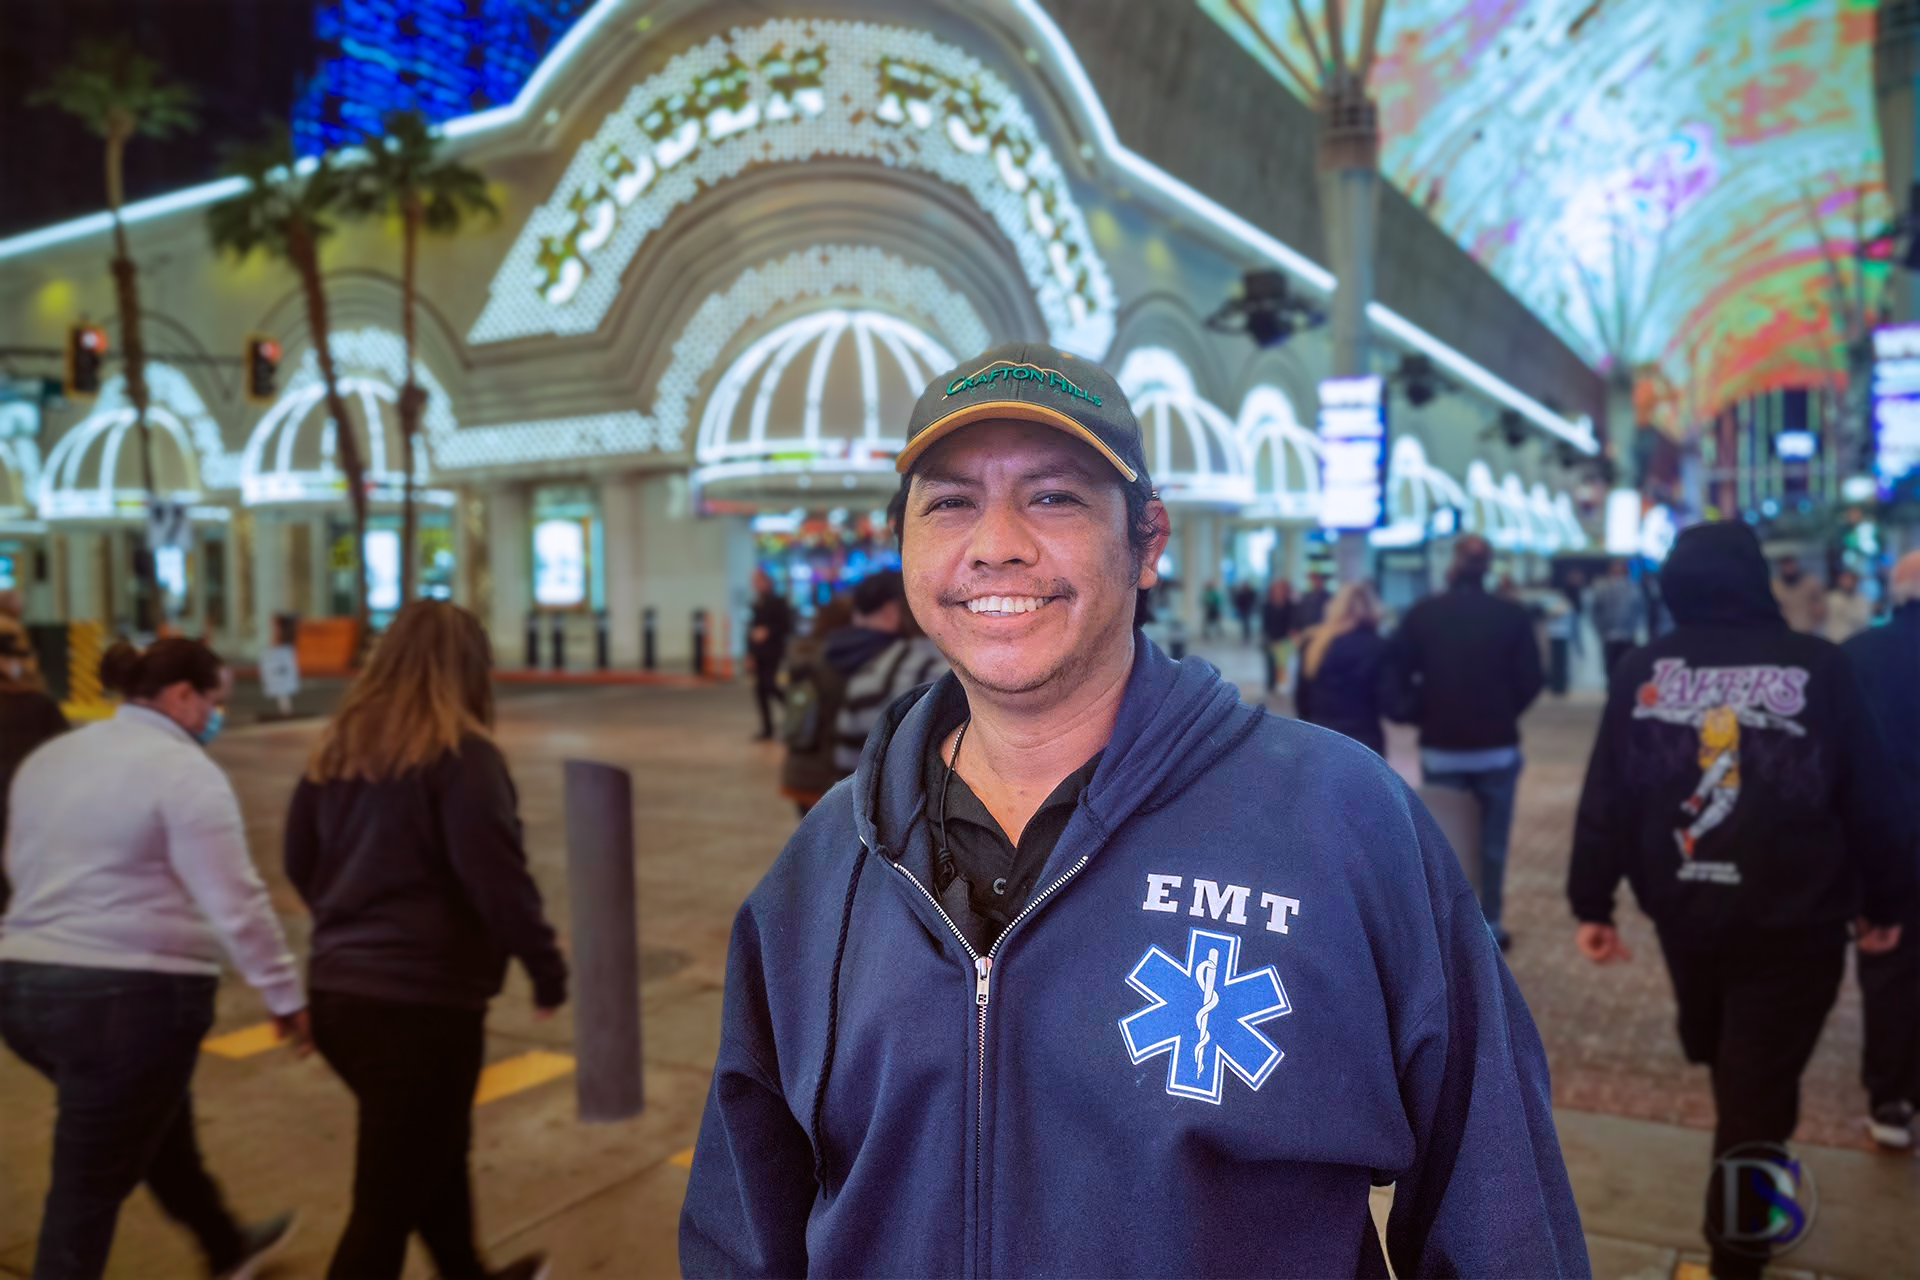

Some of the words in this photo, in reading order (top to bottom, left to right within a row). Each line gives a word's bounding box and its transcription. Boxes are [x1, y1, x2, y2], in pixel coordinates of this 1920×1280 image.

[946, 367, 1044, 396] CRAFTON
[1048, 373, 1102, 407] HILLS
[1652, 657, 1810, 717] LAKERS
[1142, 873, 1301, 935] EMT
